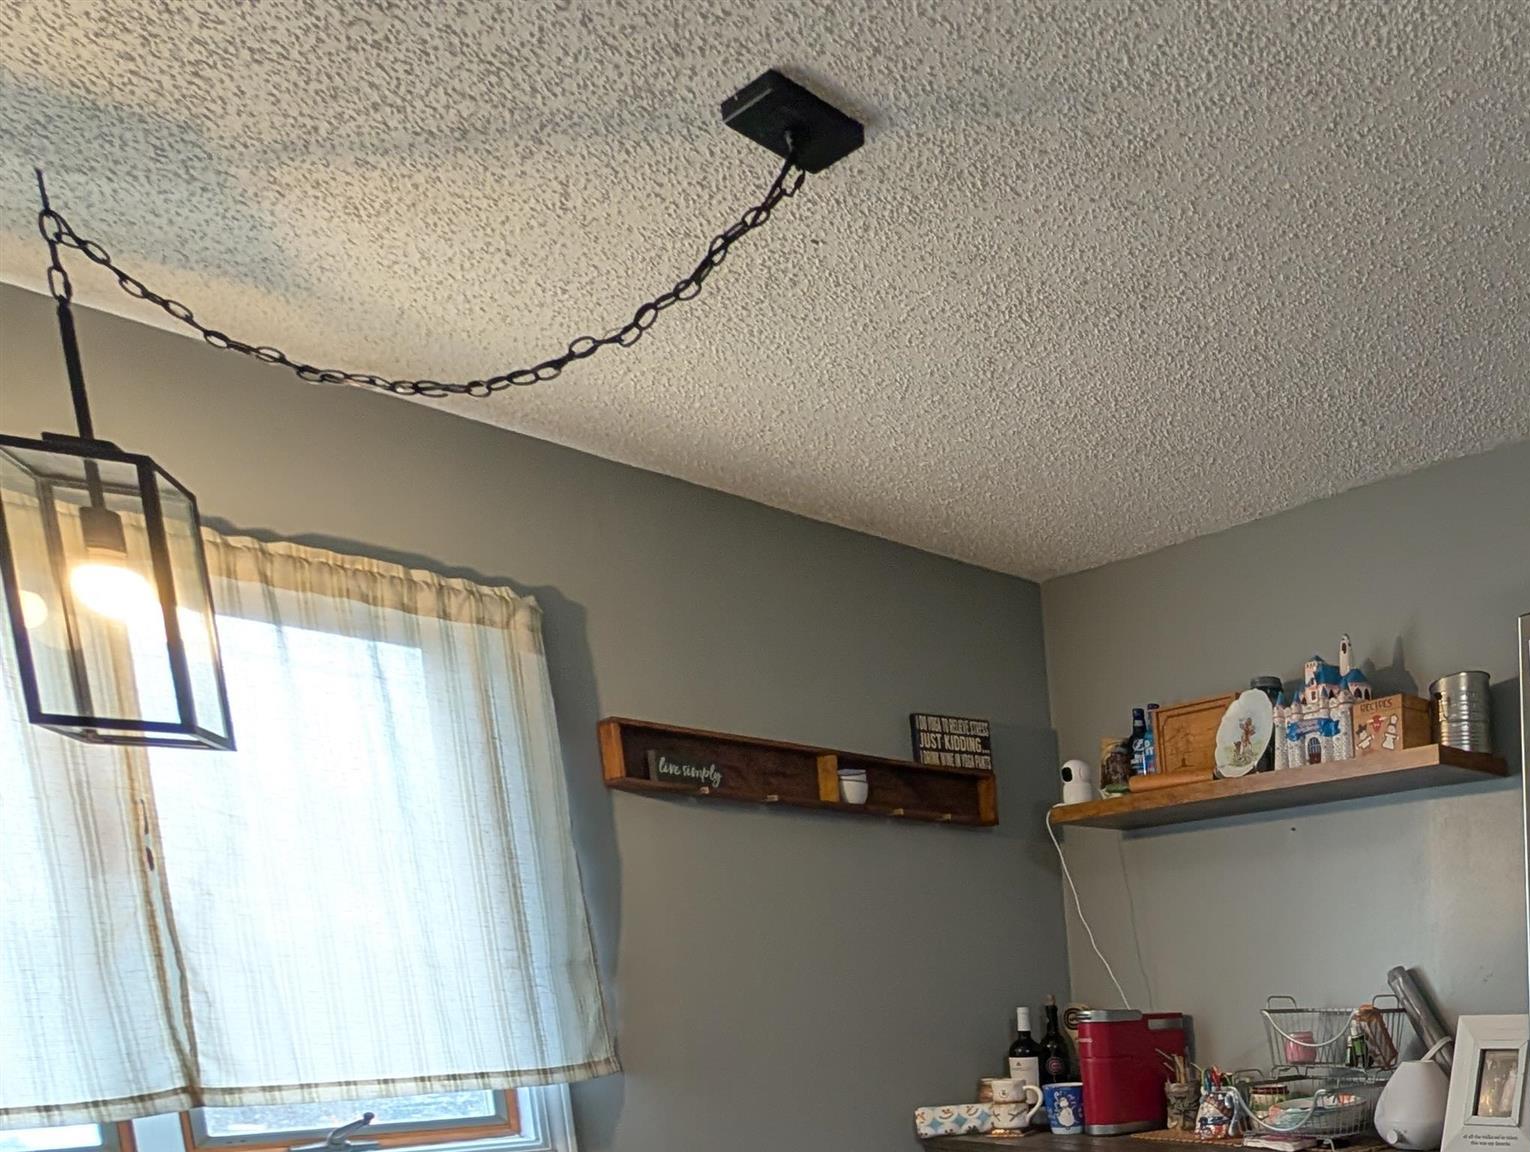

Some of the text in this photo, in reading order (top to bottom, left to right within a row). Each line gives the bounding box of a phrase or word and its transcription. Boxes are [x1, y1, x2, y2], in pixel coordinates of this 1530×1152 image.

[1360, 698, 1393, 713] RECIPES
[920, 732, 942, 749] JUST
[682, 763, 722, 788] simply
